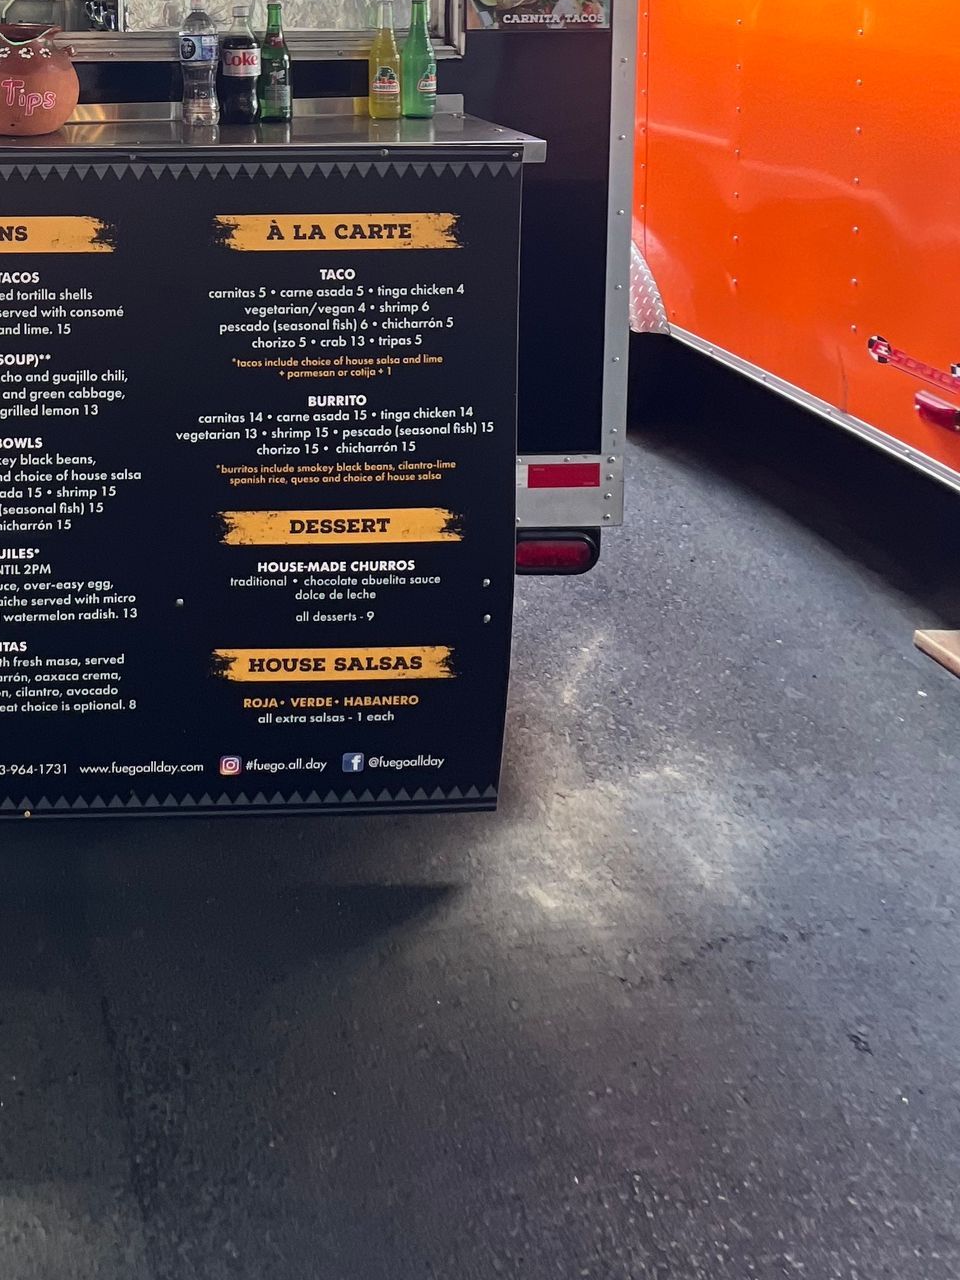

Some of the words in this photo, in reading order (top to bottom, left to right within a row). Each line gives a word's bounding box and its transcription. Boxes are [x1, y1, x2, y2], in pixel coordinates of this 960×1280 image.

[503, 14, 564, 24] CARNITA
[566, 13, 605, 24] TACOS
[224, 51, 258, 66] Coke
[1, 79, 56, 116] Tips
[267, 219, 284, 241] À
[293, 225, 326, 240] LA
[334, 223, 412, 240] CARTE
[319, 268, 355, 280] TACO
[16, 288, 56, 300] tortilla
[59, 288, 92, 300] shells
[208, 287, 255, 298] carnitas
[258, 286, 266, 297] 5
[280, 289, 313, 297] carne
[316, 284, 353, 296] asada
[356, 285, 364, 296] 5
[377, 284, 407, 298] tinga
[410, 283, 453, 295] chicken
[456, 283, 464, 294] 4
[264, 357, 298, 366] include
[300, 356, 331, 366] choice
[333, 355, 343, 365] of
[345, 355, 374, 365] house
[376, 354, 400, 364] salsa
[402, 354, 421, 363] and
[423, 353, 442, 362] lime
[308, 394, 366, 406] BURRITO
[256, 443, 300, 454] chorizo
[304, 443, 318, 454] 15
[336, 441, 397, 453] chicharrón
[402, 441, 416, 451] 15
[20, 453, 53, 465] black
[56, 453, 96, 465] beans,
[290, 518, 391, 535] DESSERT
[23, 563, 51, 574] 2PM
[257, 561, 346, 572] HOUSE-MADE
[350, 559, 415, 571] CHURROS
[294, 588, 325, 599] dolce
[329, 588, 343, 599] de
[347, 588, 376, 599] leche
[295, 610, 309, 621] all
[312, 610, 356, 621] desserts
[366, 611, 374, 620] 9
[248, 657, 326, 673] HOUSE
[334, 656, 423, 671] SALSAS
[34, 673, 79, 681] oaxaca
[82, 672, 121, 680] crema,
[344, 695, 418, 706] HABANERO
[245, 757, 327, 772] #fuego.all.day
[368, 754, 444, 769] @fuegoallday
[79, 762, 204, 776] www.fuegoallday.com
